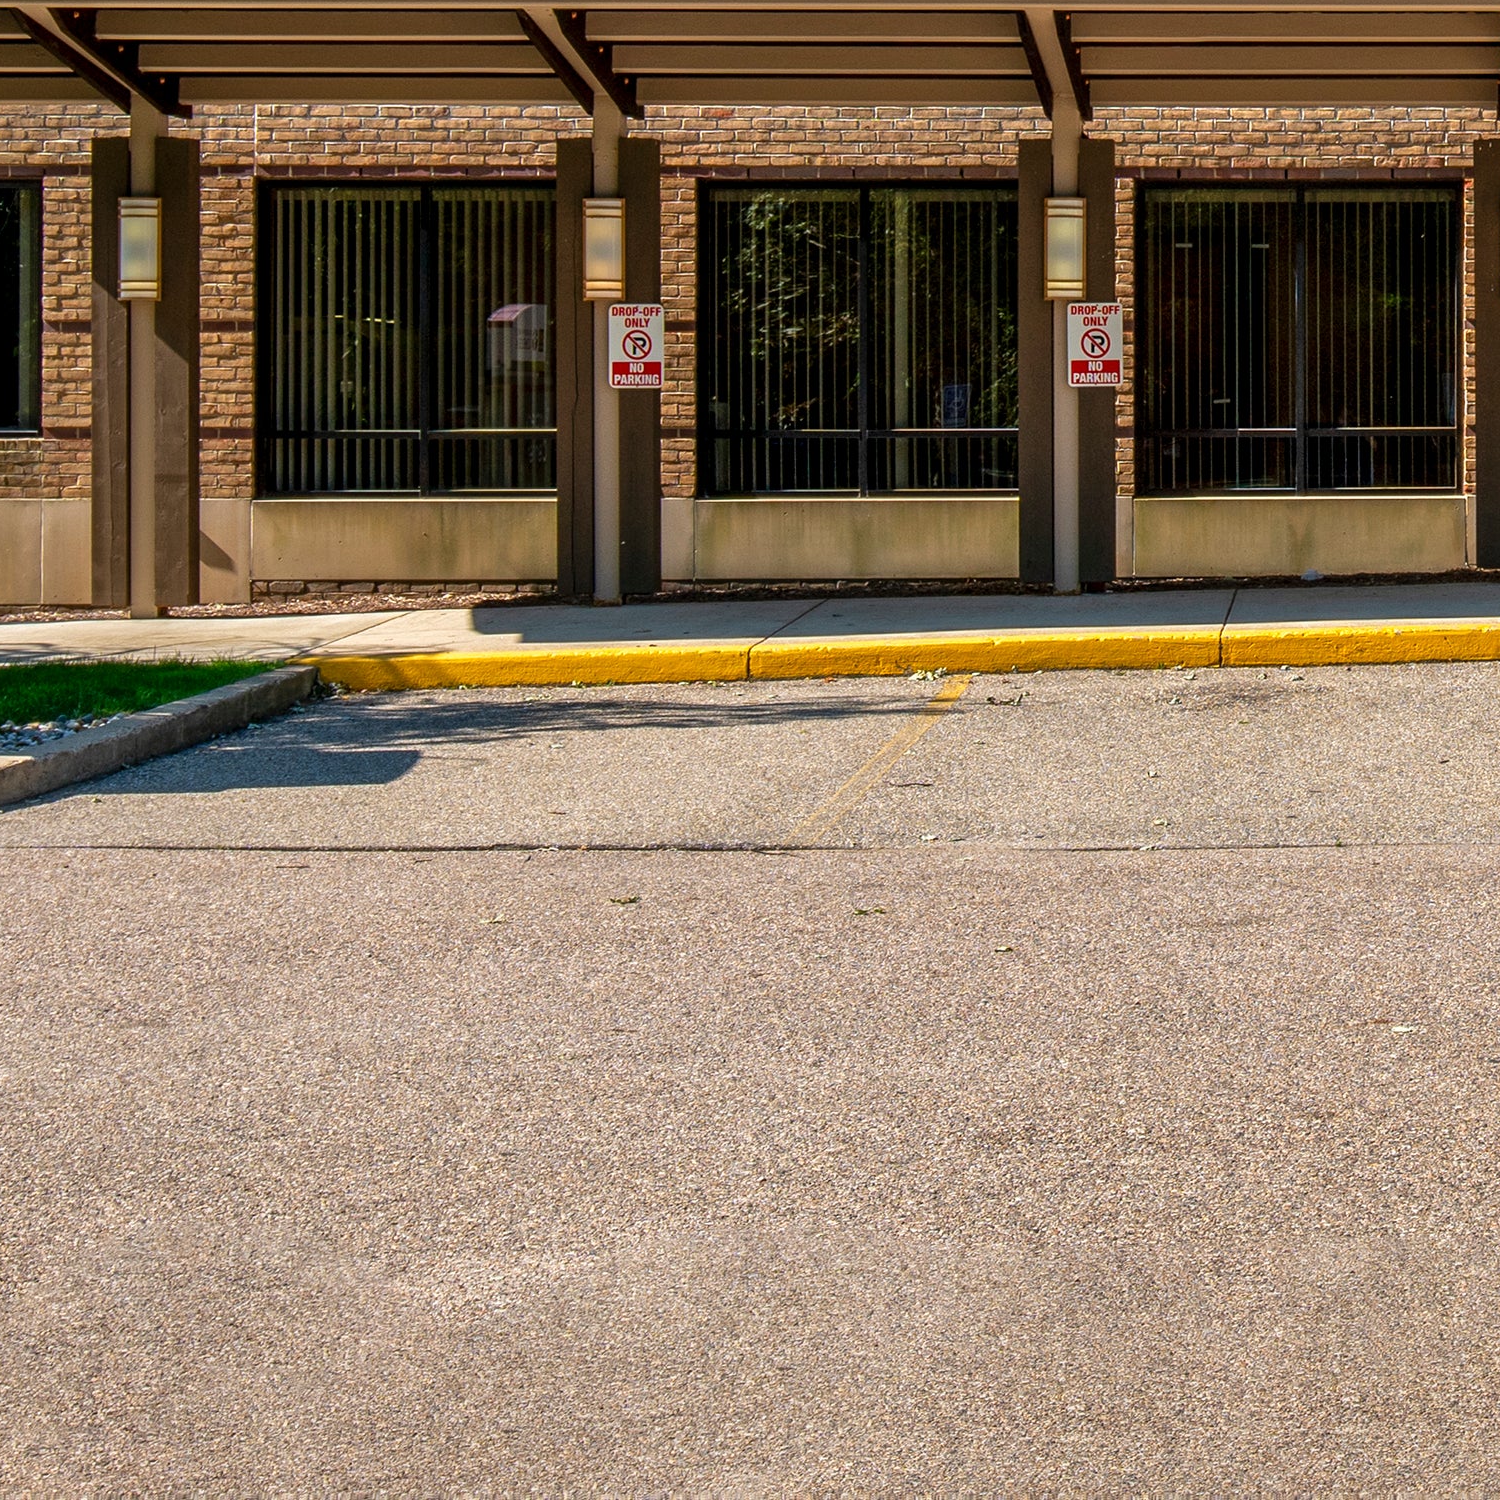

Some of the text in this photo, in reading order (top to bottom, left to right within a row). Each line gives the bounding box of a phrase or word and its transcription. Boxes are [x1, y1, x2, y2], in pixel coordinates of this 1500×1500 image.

[611, 306, 662, 316] DROP-OFF
[1070, 305, 1120, 315] DROP-OFF
[624, 318, 650, 328] ONLY
[1083, 316, 1109, 326] ONLY
[629, 362, 644, 373] NO
[1088, 361, 1103, 371] NO
[614, 374, 659, 385] PARKING
[1073, 372, 1118, 383] PARKING
